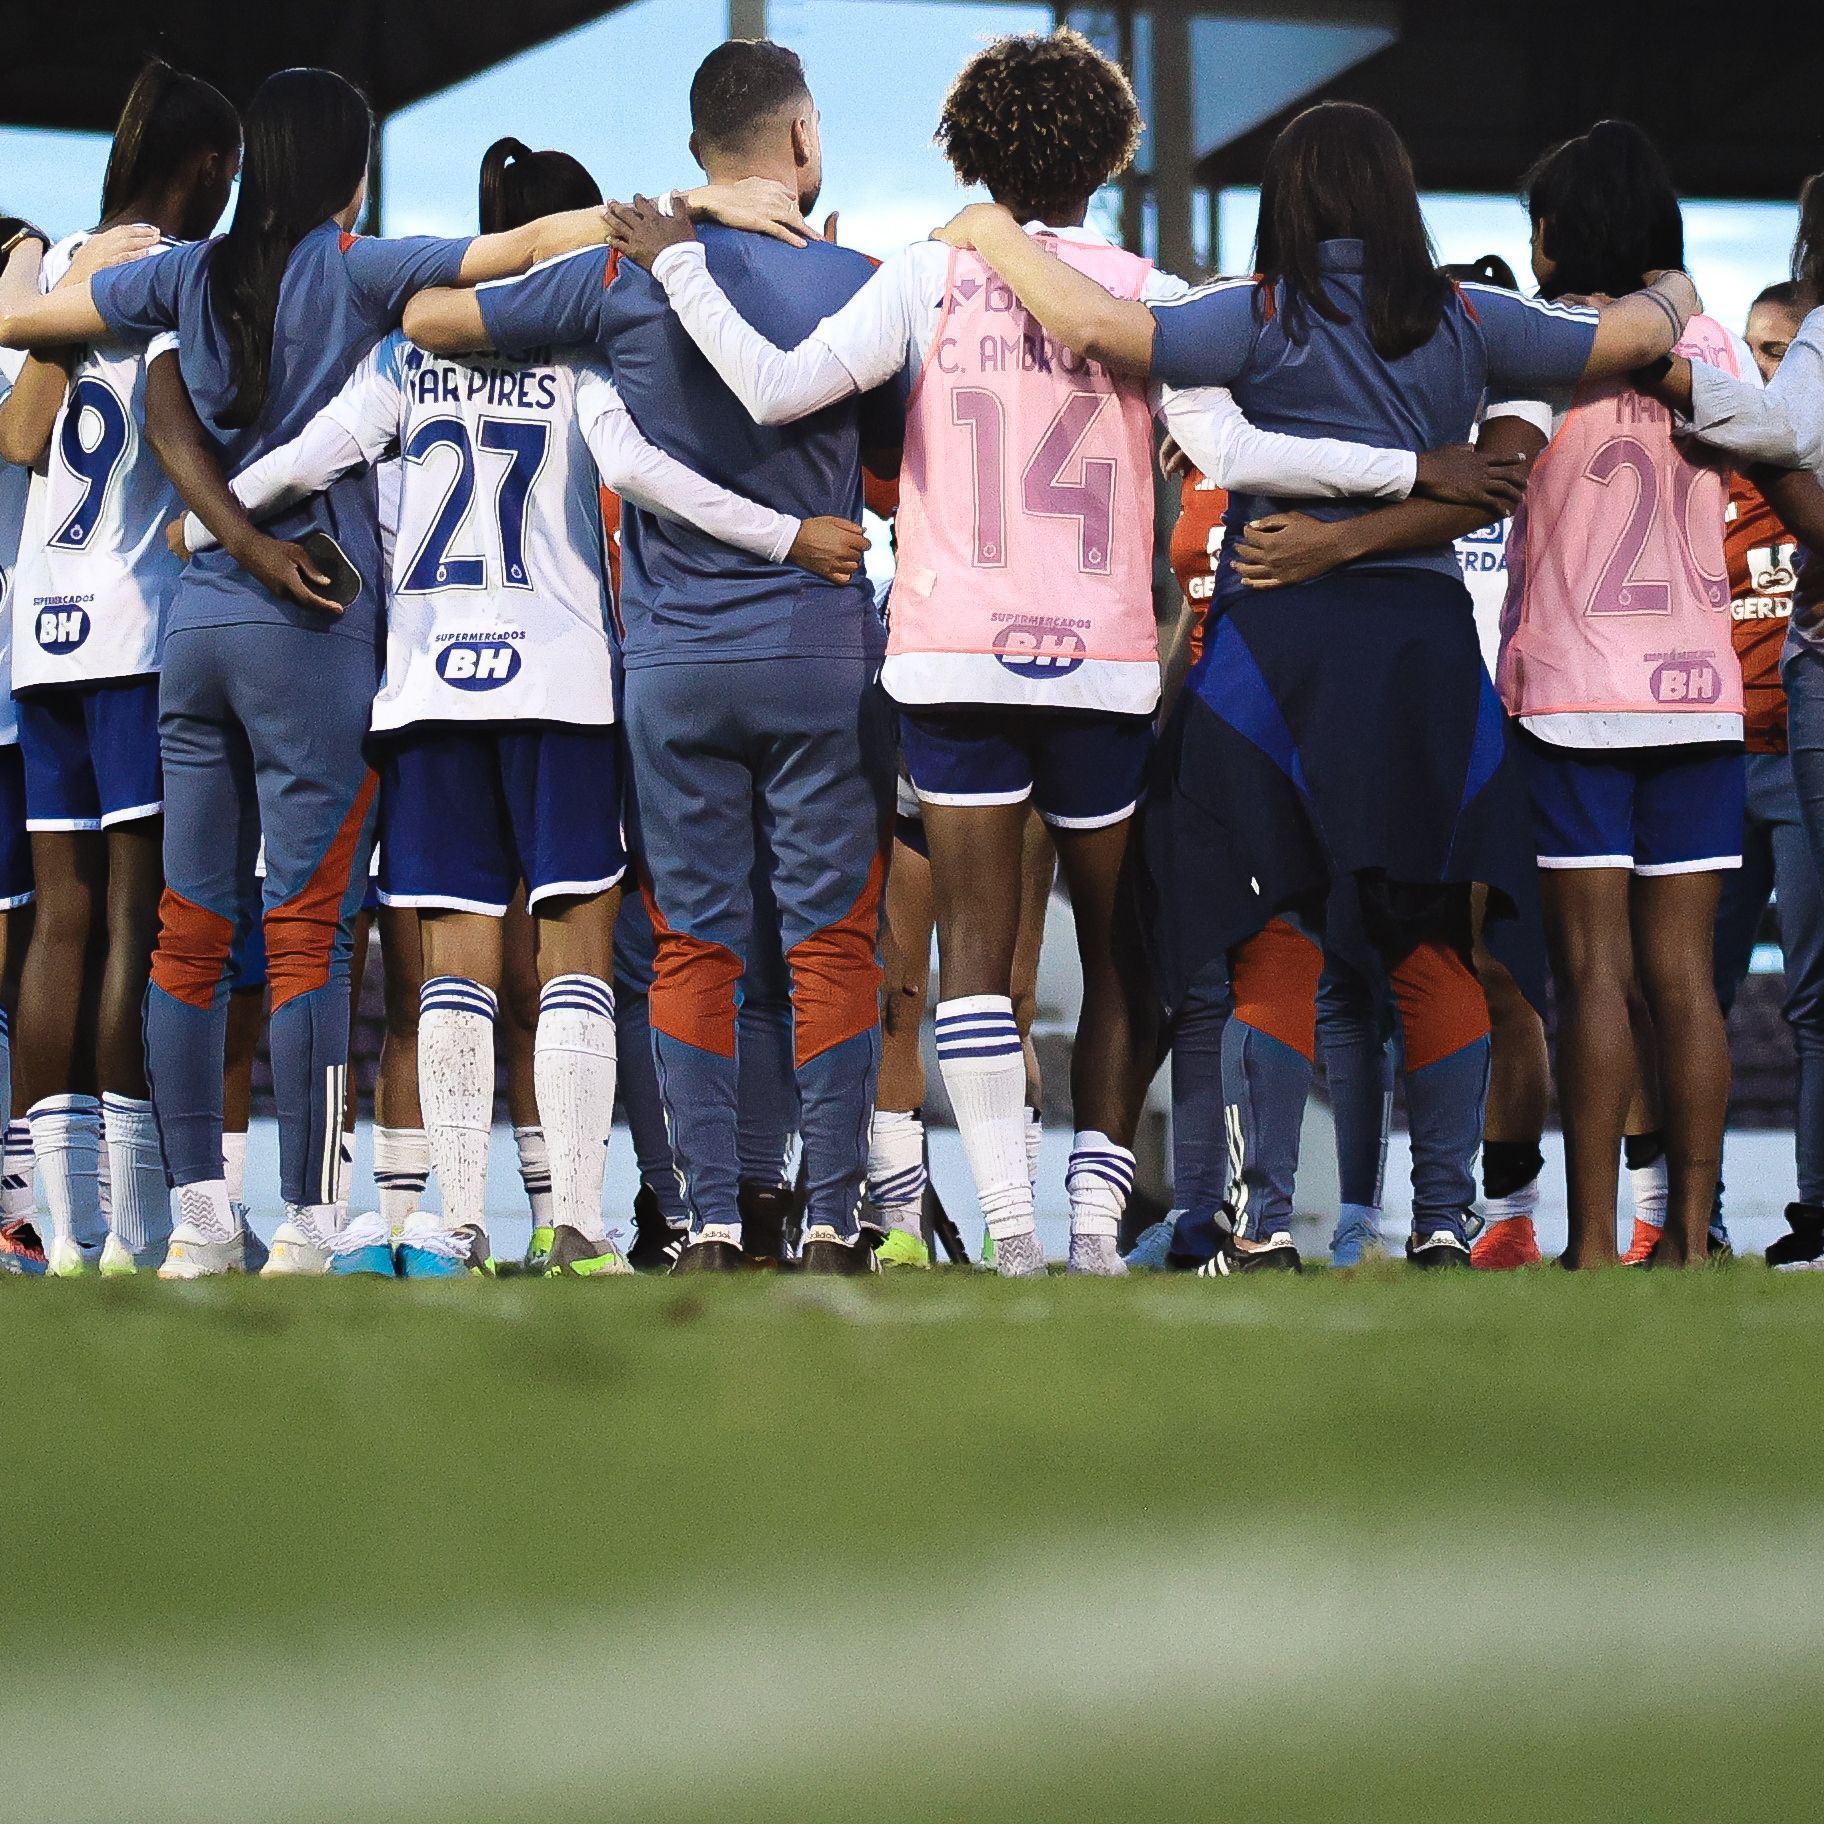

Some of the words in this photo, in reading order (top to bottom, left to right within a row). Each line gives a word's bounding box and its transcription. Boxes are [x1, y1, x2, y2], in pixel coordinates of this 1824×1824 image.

[466, 365, 558, 410] PIRES
[47, 376, 130, 551] 9
[951, 386, 1117, 576] 14
[396, 414, 552, 596] 27
[991, 612, 1092, 629] SUPERMERCADOS
[1729, 596, 1794, 621] GERD
[39, 610, 84, 644] BH
[435, 630, 527, 642] SUPERMERCADOS
[443, 648, 513, 679] BH
[1001, 632, 1078, 667] BH
[1658, 667, 1713, 701] BH
